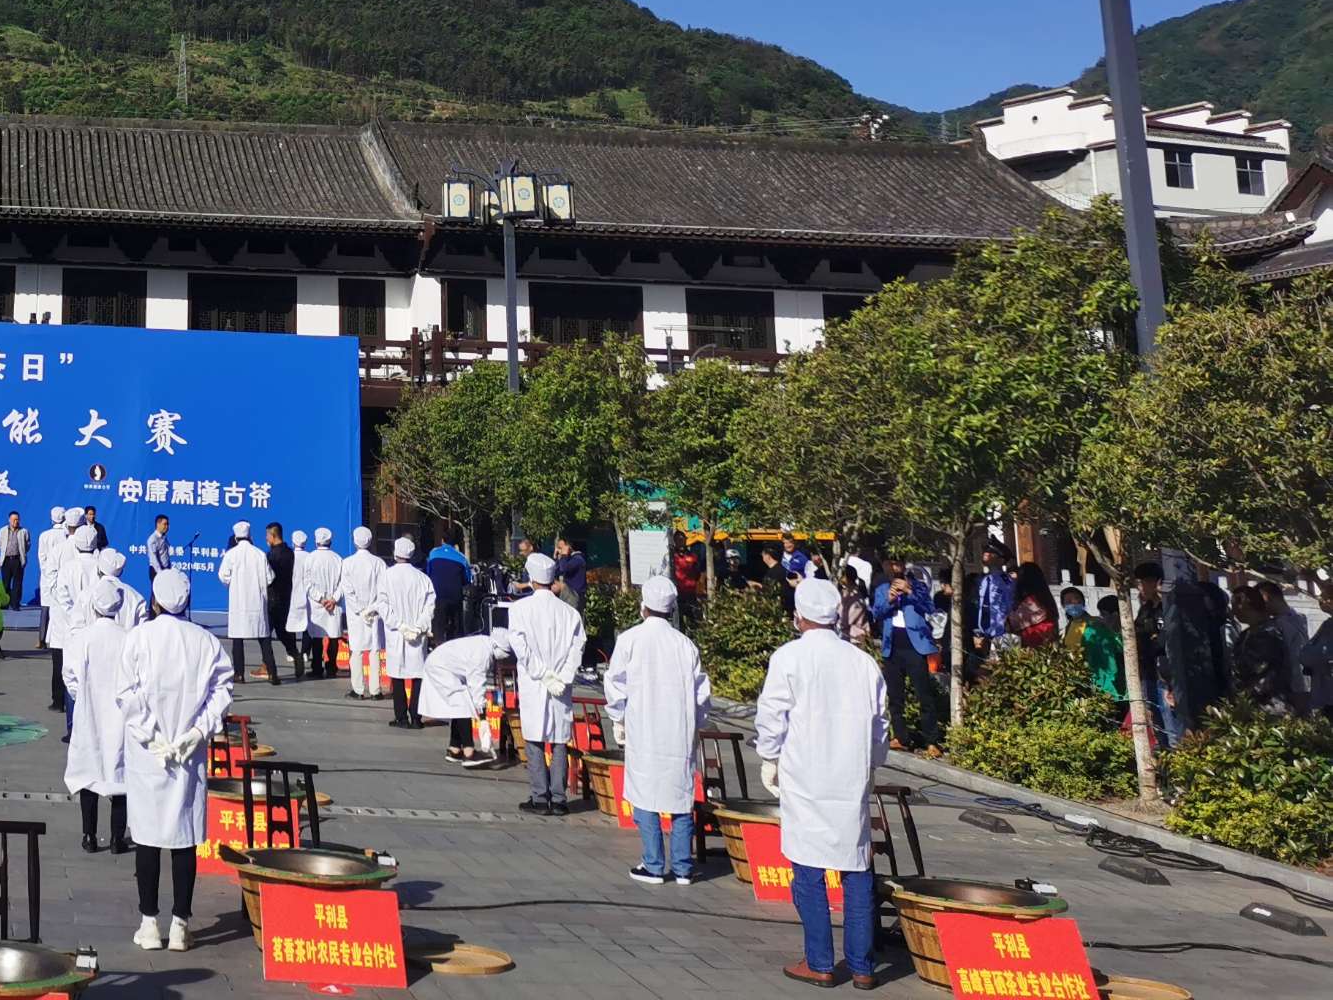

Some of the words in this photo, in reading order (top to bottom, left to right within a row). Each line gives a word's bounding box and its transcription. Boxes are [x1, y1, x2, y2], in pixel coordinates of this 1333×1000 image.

[314, 903, 348, 929] 平利县
[272, 936, 397, 969] 茗香茶叶农民专业合作社
[991, 932, 1031, 959] 平利县
